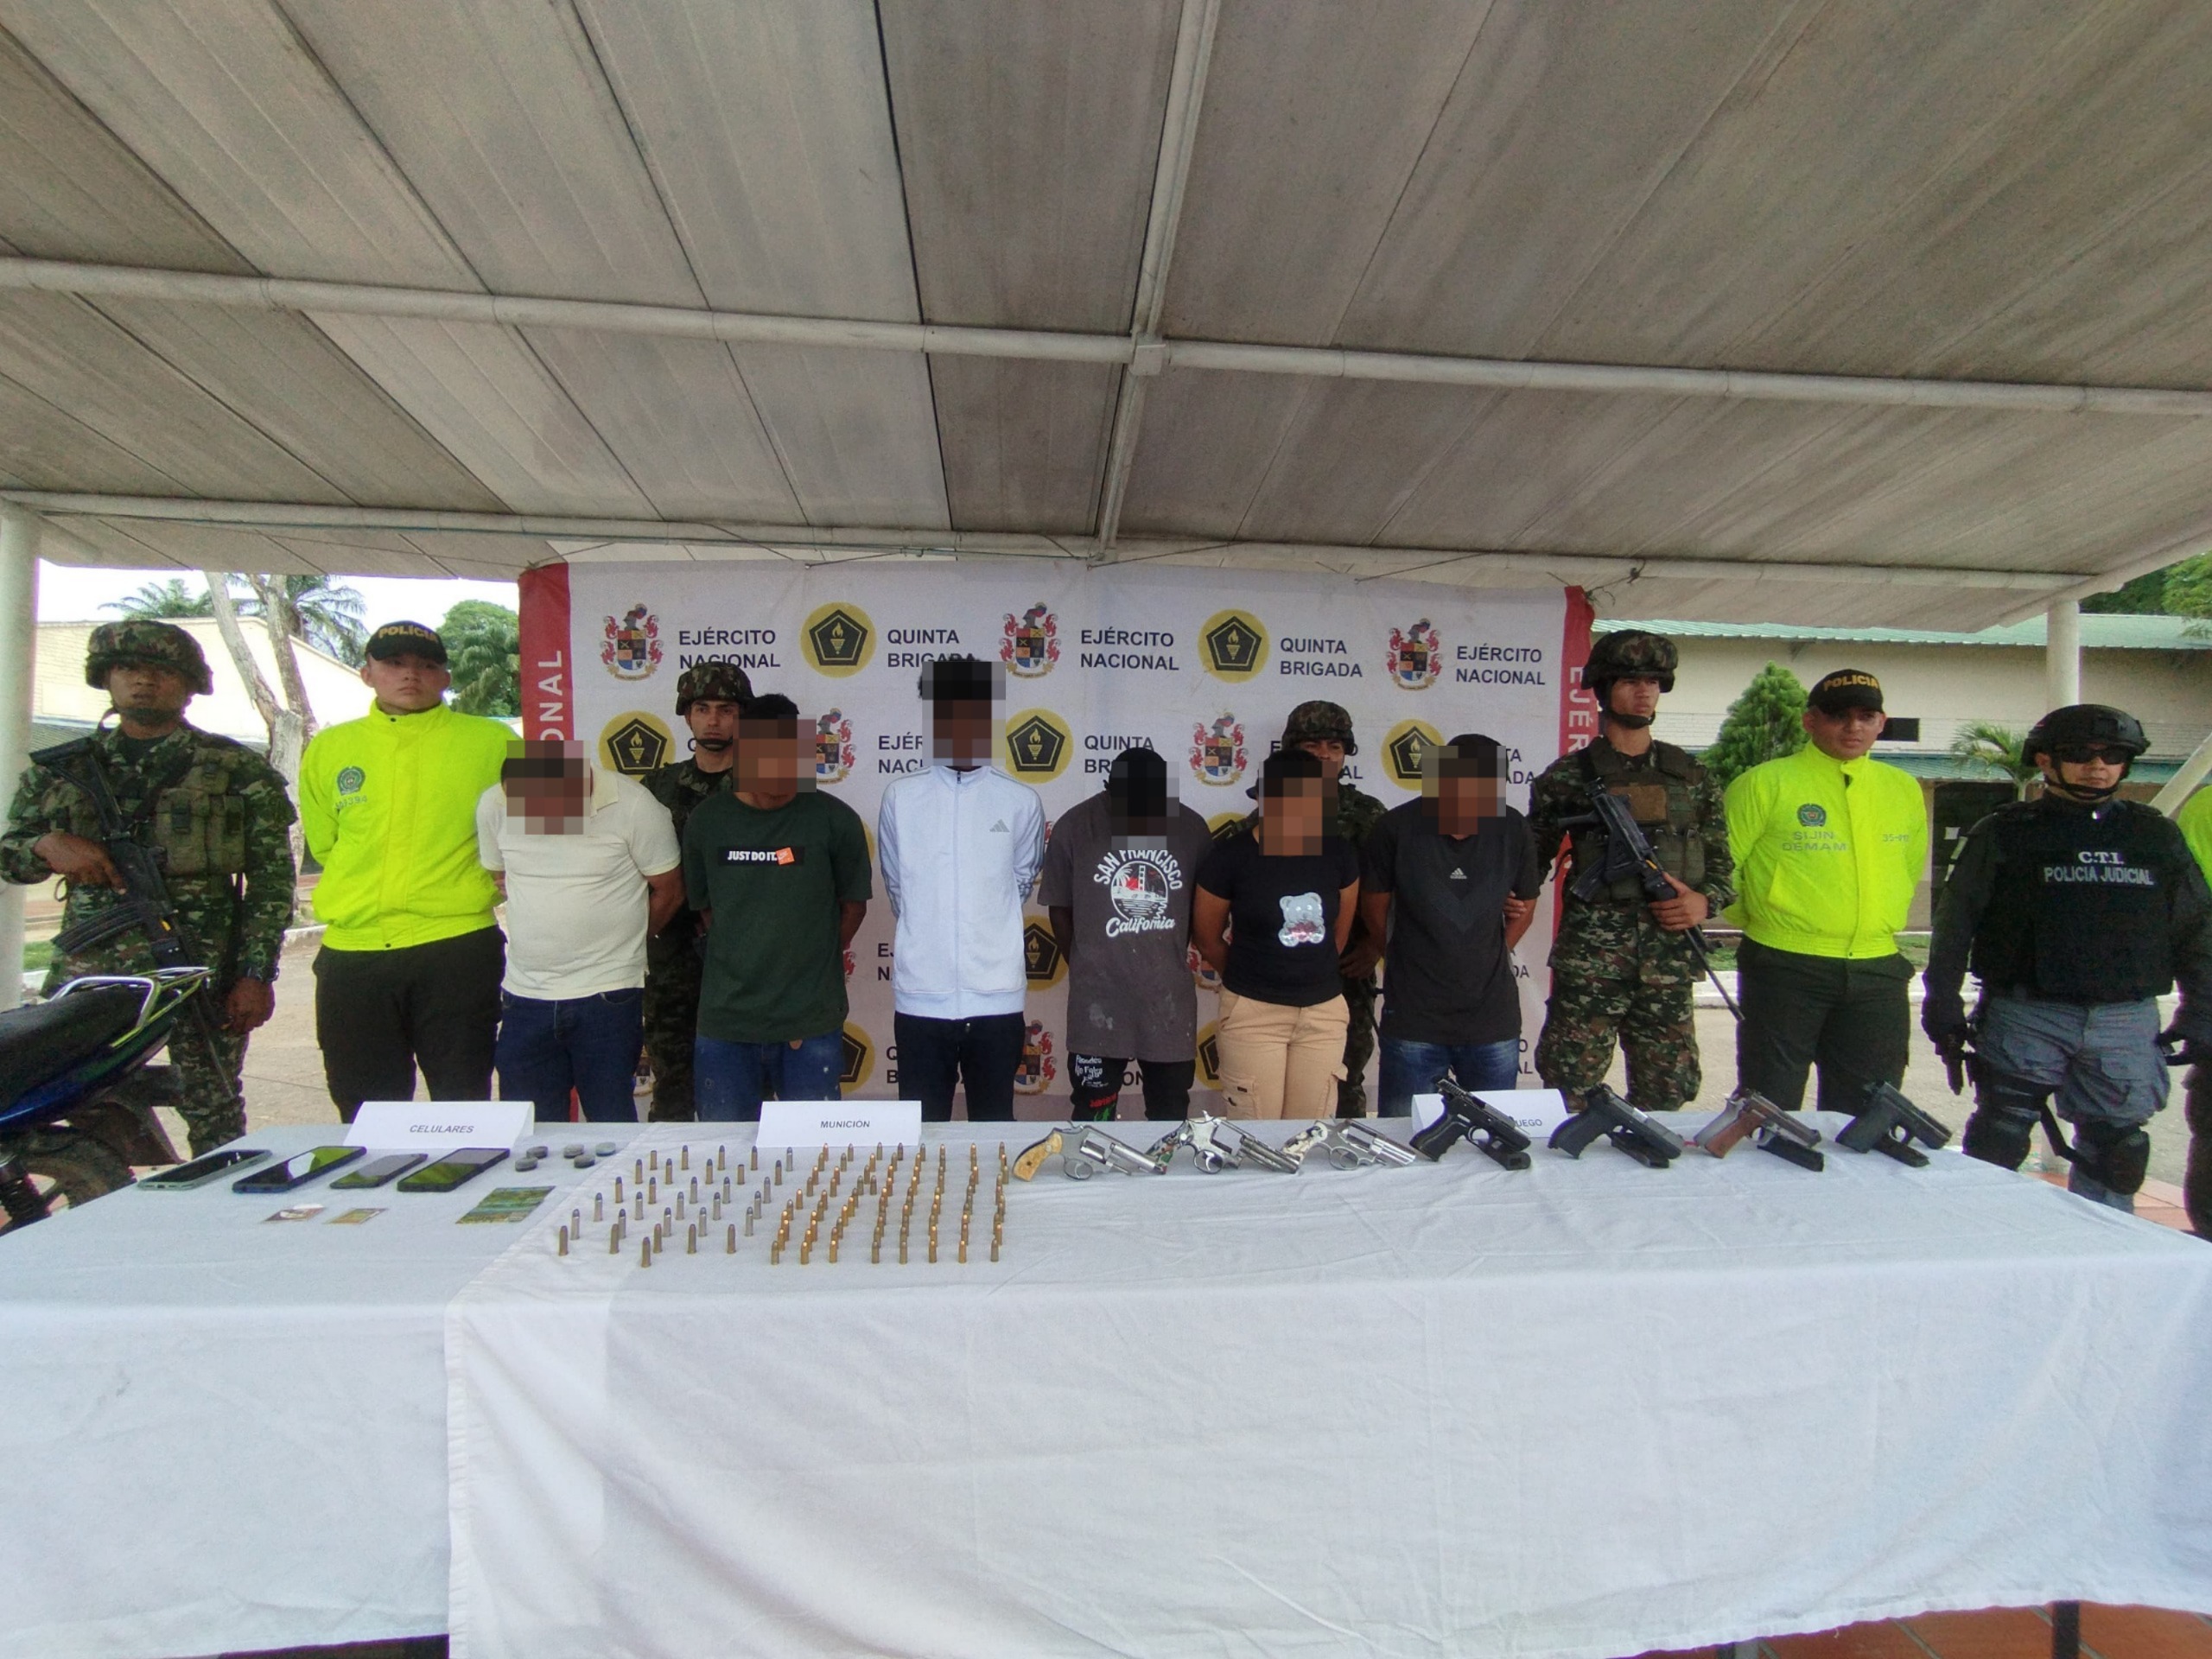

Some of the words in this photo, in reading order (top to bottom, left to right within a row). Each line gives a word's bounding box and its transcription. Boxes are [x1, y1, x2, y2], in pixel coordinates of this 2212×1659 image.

[679, 626, 776, 645] EJÉRCITO
[887, 629, 960, 645] QUINTA
[1081, 626, 1173, 646] EJÉRCITO
[1280, 639, 1346, 654] QUINTA
[1457, 644, 1541, 663] EJÉRCITO
[1081, 654, 1179, 671] NACIONAL
[1280, 661, 1363, 677] BRIGADA
[1456, 669, 1545, 685] NACIONAL
[1568, 666, 1593, 753] EJÉR
[879, 732, 922, 750] EJÉR
[1084, 735, 1154, 752] QUINTA
[728, 850, 750, 861] JUST
[751, 851, 766, 861] DO
[1093, 851, 1121, 885] SAN
[2100, 867, 2154, 885] JUDICIAL
[1106, 916, 1176, 938] California
[410, 1124, 474, 1134] CELULARES
[1516, 1119, 1542, 1128] UEGO
